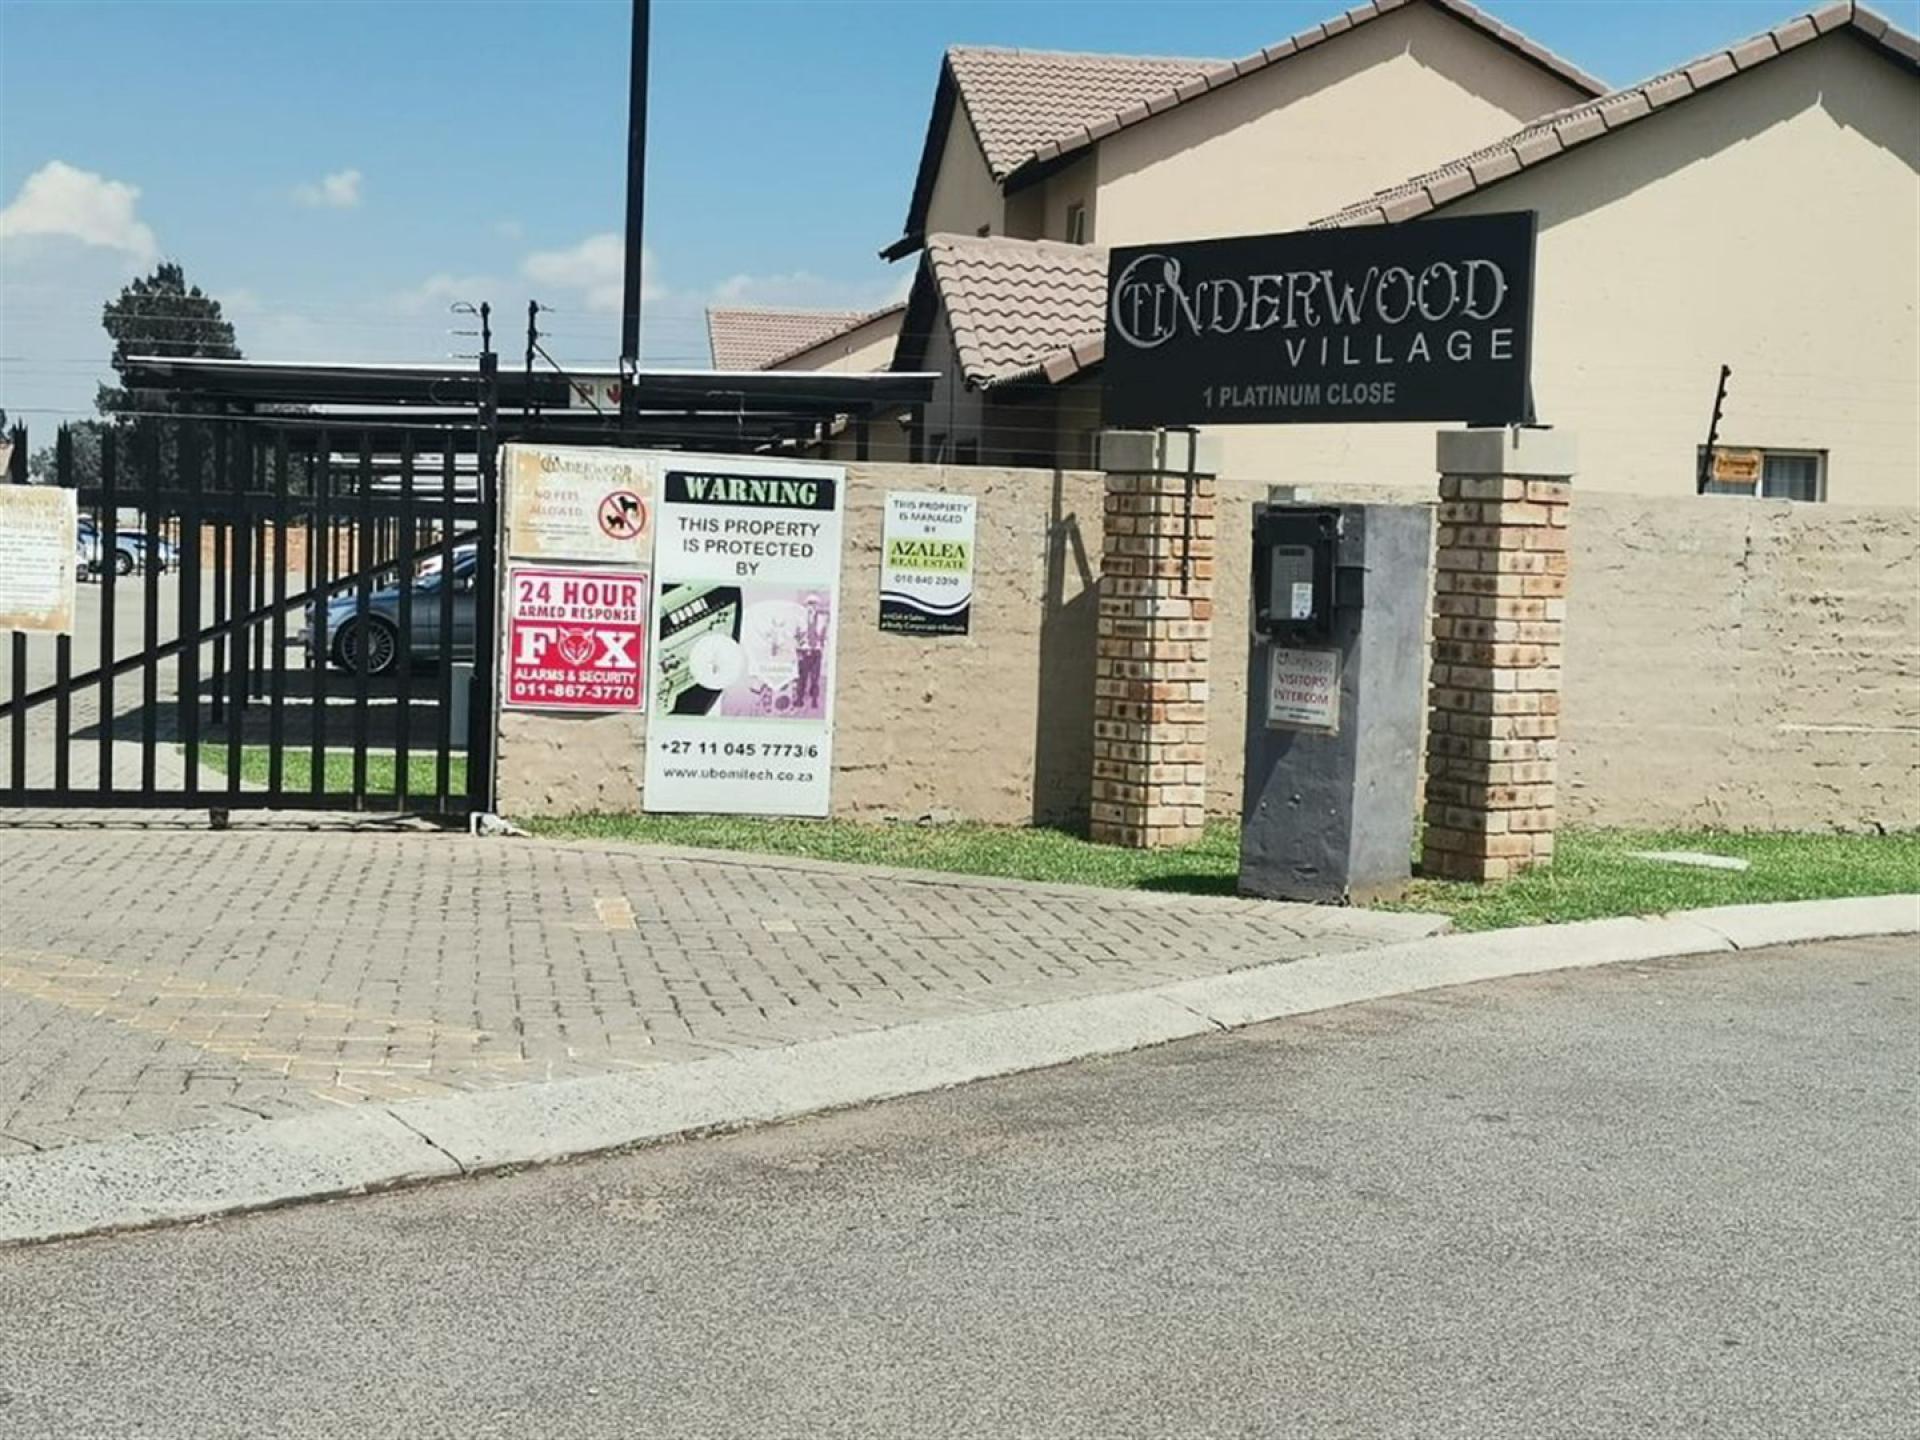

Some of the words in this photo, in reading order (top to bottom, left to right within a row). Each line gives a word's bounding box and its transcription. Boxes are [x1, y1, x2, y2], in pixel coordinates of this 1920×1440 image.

[1285, 327, 1514, 367] VILLAGE
[1203, 386, 1213, 408] 1
[1218, 384, 1321, 407] PLATINUM
[1326, 382, 1396, 404] CLOSE
[684, 476, 817, 505] WARNING
[919, 502, 970, 512] PROPERTY
[678, 516, 719, 533] THIS
[724, 519, 821, 537] PROPERTY
[911, 512, 963, 524] MANAGED
[683, 538, 699, 553] IS
[704, 539, 813, 557] PROTECTED
[891, 541, 965, 559] AZALEA
[735, 561, 760, 576] BY
[890, 557, 918, 568] REAL
[923, 559, 964, 569] ESTATE
[519, 580, 552, 604] 24
[563, 583, 638, 608] HOUR
[518, 605, 566, 618] ARMED
[571, 606, 637, 622] RESPONSE
[514, 668, 565, 682] ALARMS
[567, 670, 576, 682] &
[578, 669, 637, 685] SECURITY
[515, 682, 634, 700] 011-867-3770
[1273, 688, 1329, 705] INTERCOM
[661, 740, 692, 755] +27
[699, 742, 717, 755] 11
[723, 742, 756, 756] 045
[663, 767, 813, 782] www.ubomitech.co.za
